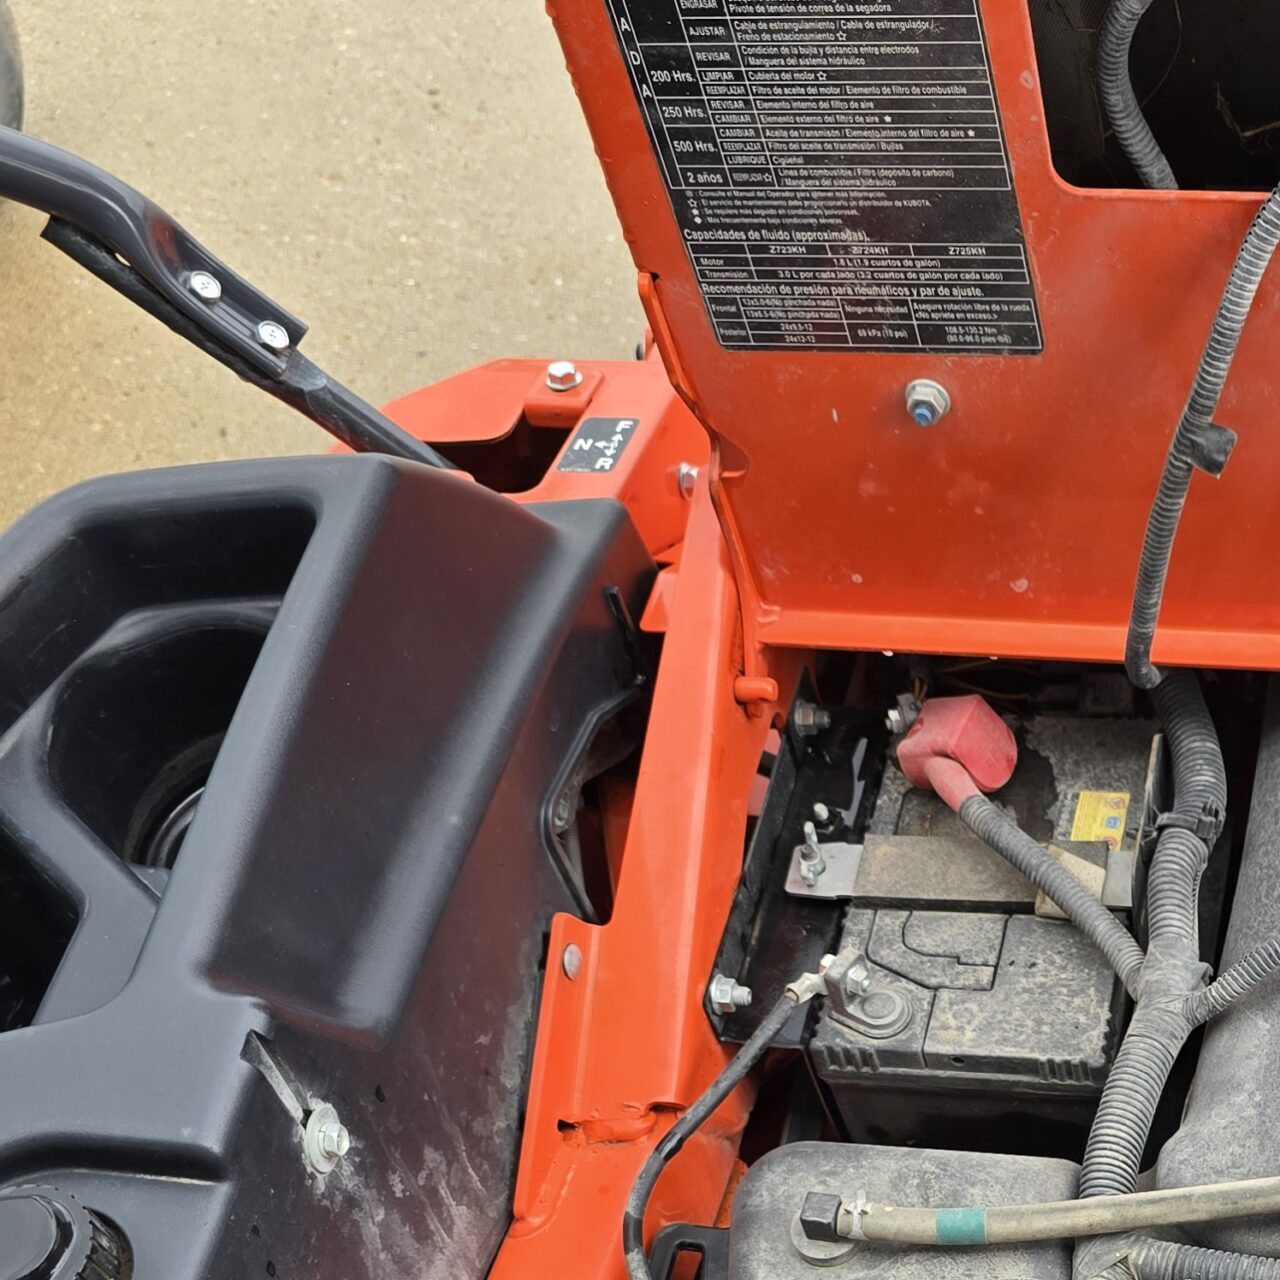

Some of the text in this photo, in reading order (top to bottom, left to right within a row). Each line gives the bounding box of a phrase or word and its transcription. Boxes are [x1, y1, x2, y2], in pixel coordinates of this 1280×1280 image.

[689, 26, 726, 35] AJUSTAR
[616, 421, 633, 432] F
[574, 439, 593, 450] N
[594, 458, 614, 470] R
